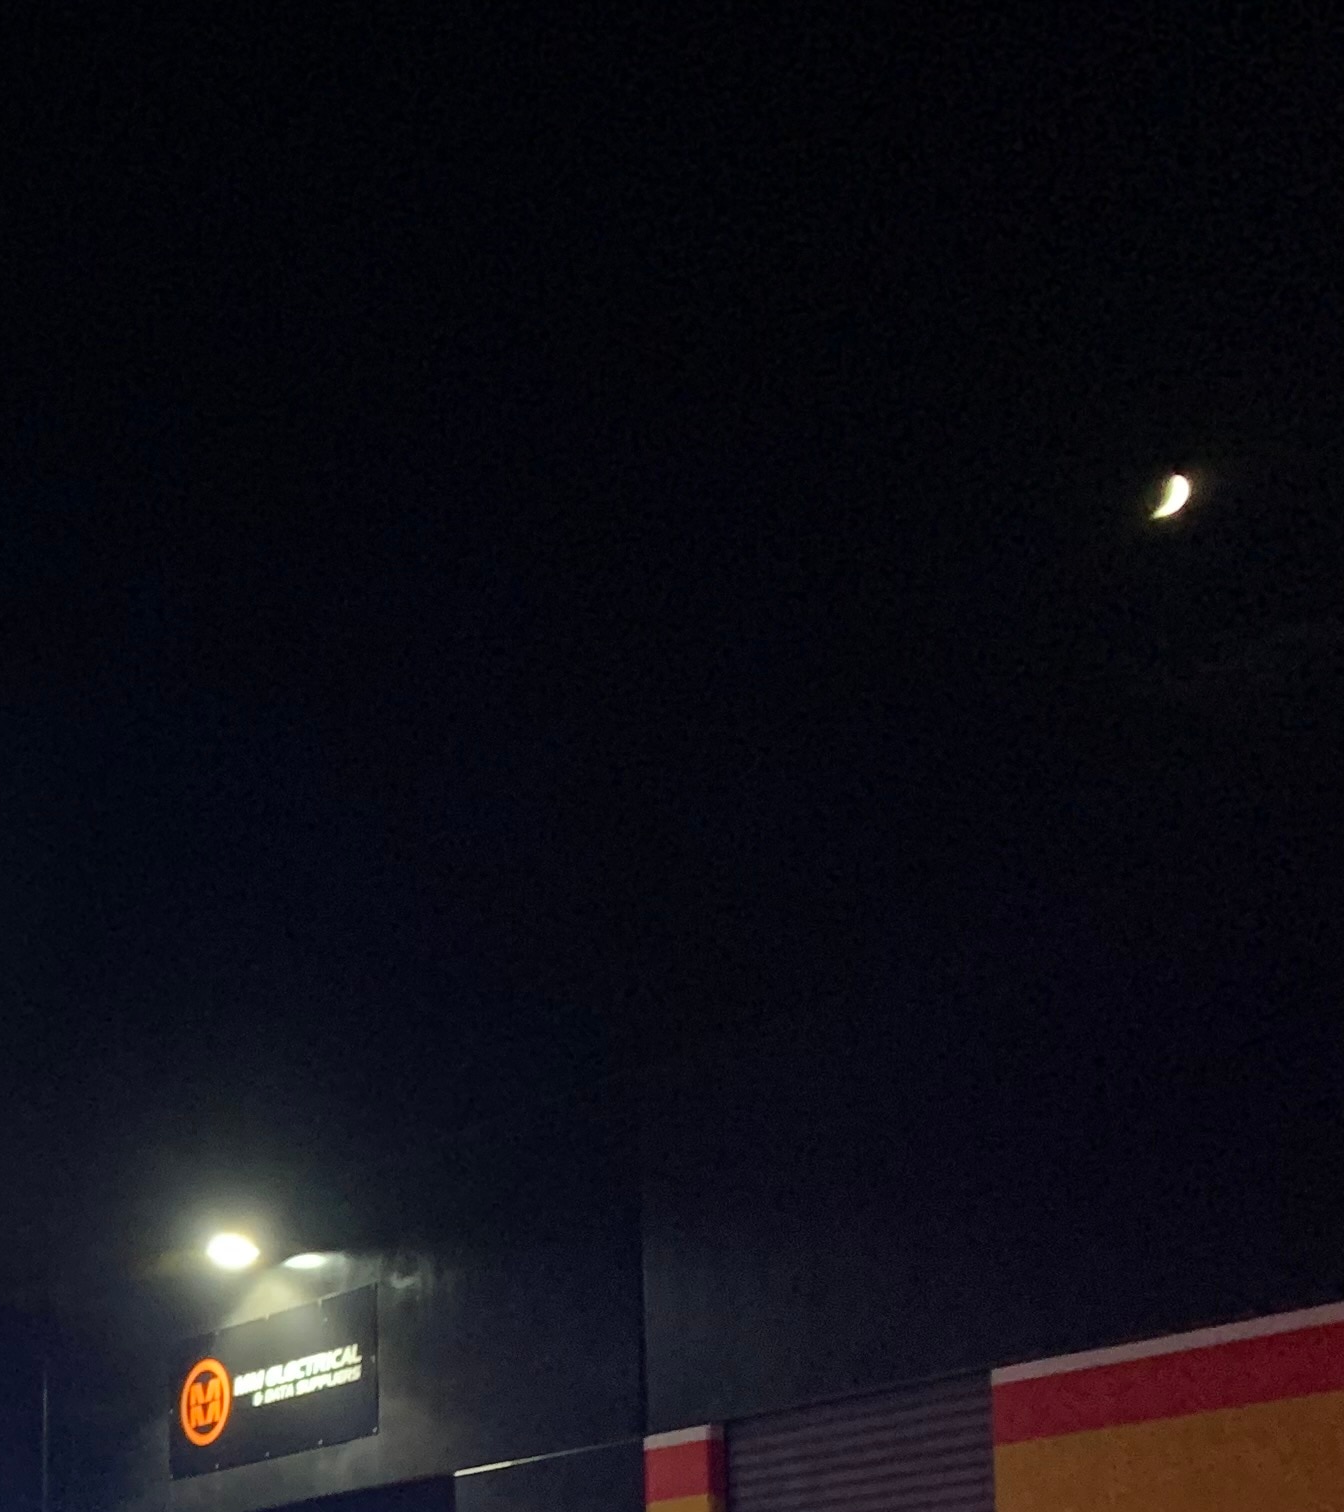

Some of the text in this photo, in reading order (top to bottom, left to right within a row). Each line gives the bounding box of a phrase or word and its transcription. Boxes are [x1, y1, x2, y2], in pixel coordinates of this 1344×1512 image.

[264, 1383, 294, 1405] DATA
[295, 1365, 362, 1397] SUPPLIERS
[265, 1344, 363, 1388] ELECTRICAL
